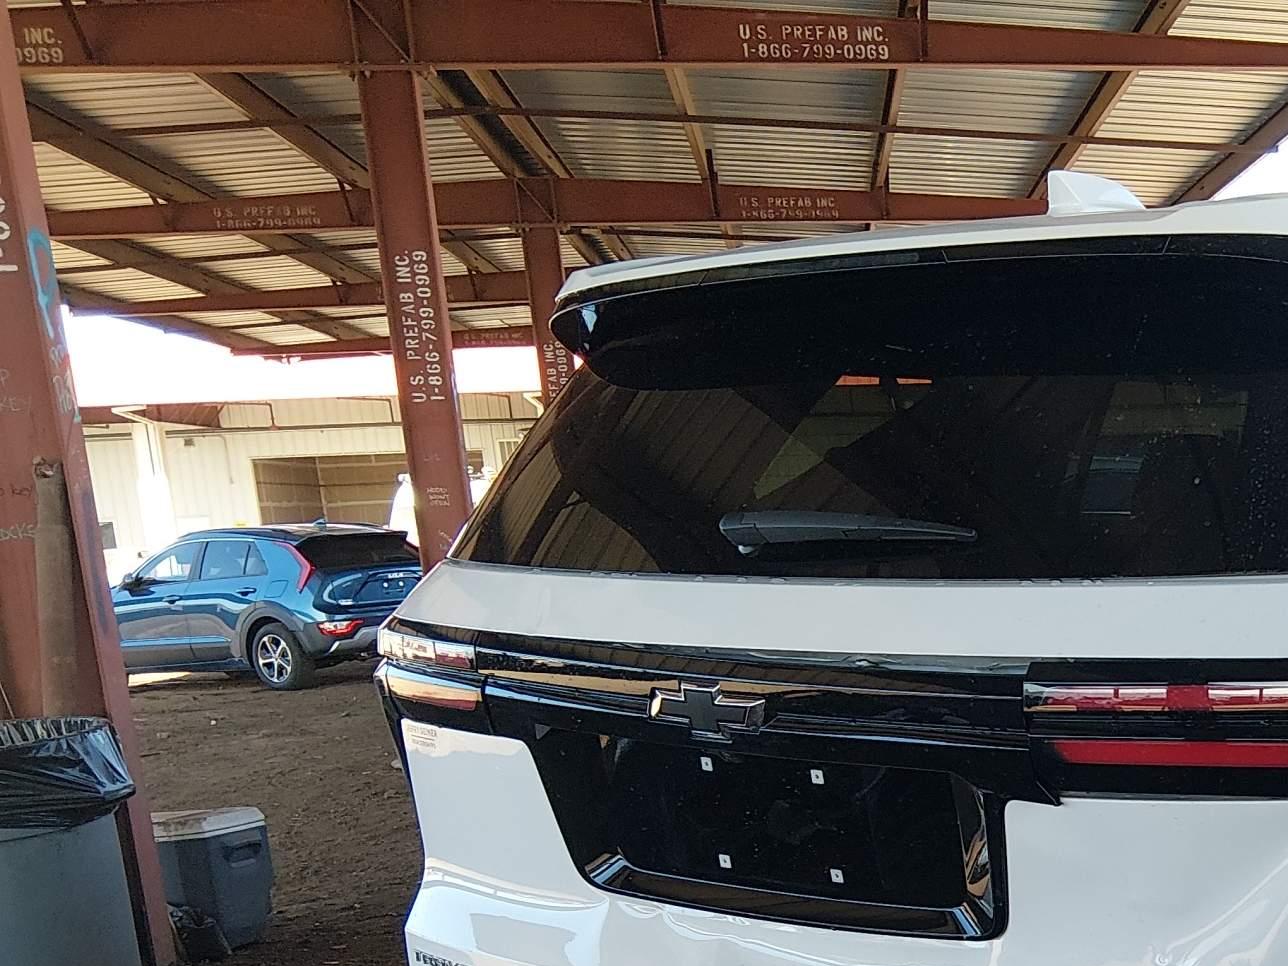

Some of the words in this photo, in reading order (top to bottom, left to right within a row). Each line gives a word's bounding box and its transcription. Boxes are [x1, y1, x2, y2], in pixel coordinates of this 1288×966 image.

[23, 27, 63, 44] INC.
[738, 24, 773, 40] U.S.
[781, 25, 849, 42] PREFAB
[857, 26, 890, 42] INC.
[742, 43, 890, 60] 1-866-799-0969
[767, 197, 813, 208] PREFAB
[394, 250, 412, 283] INC.
[399, 292, 423, 360] PREFAB
[411, 250, 446, 401] 1-866-799-0969
[409, 370, 427, 403] U.S.
